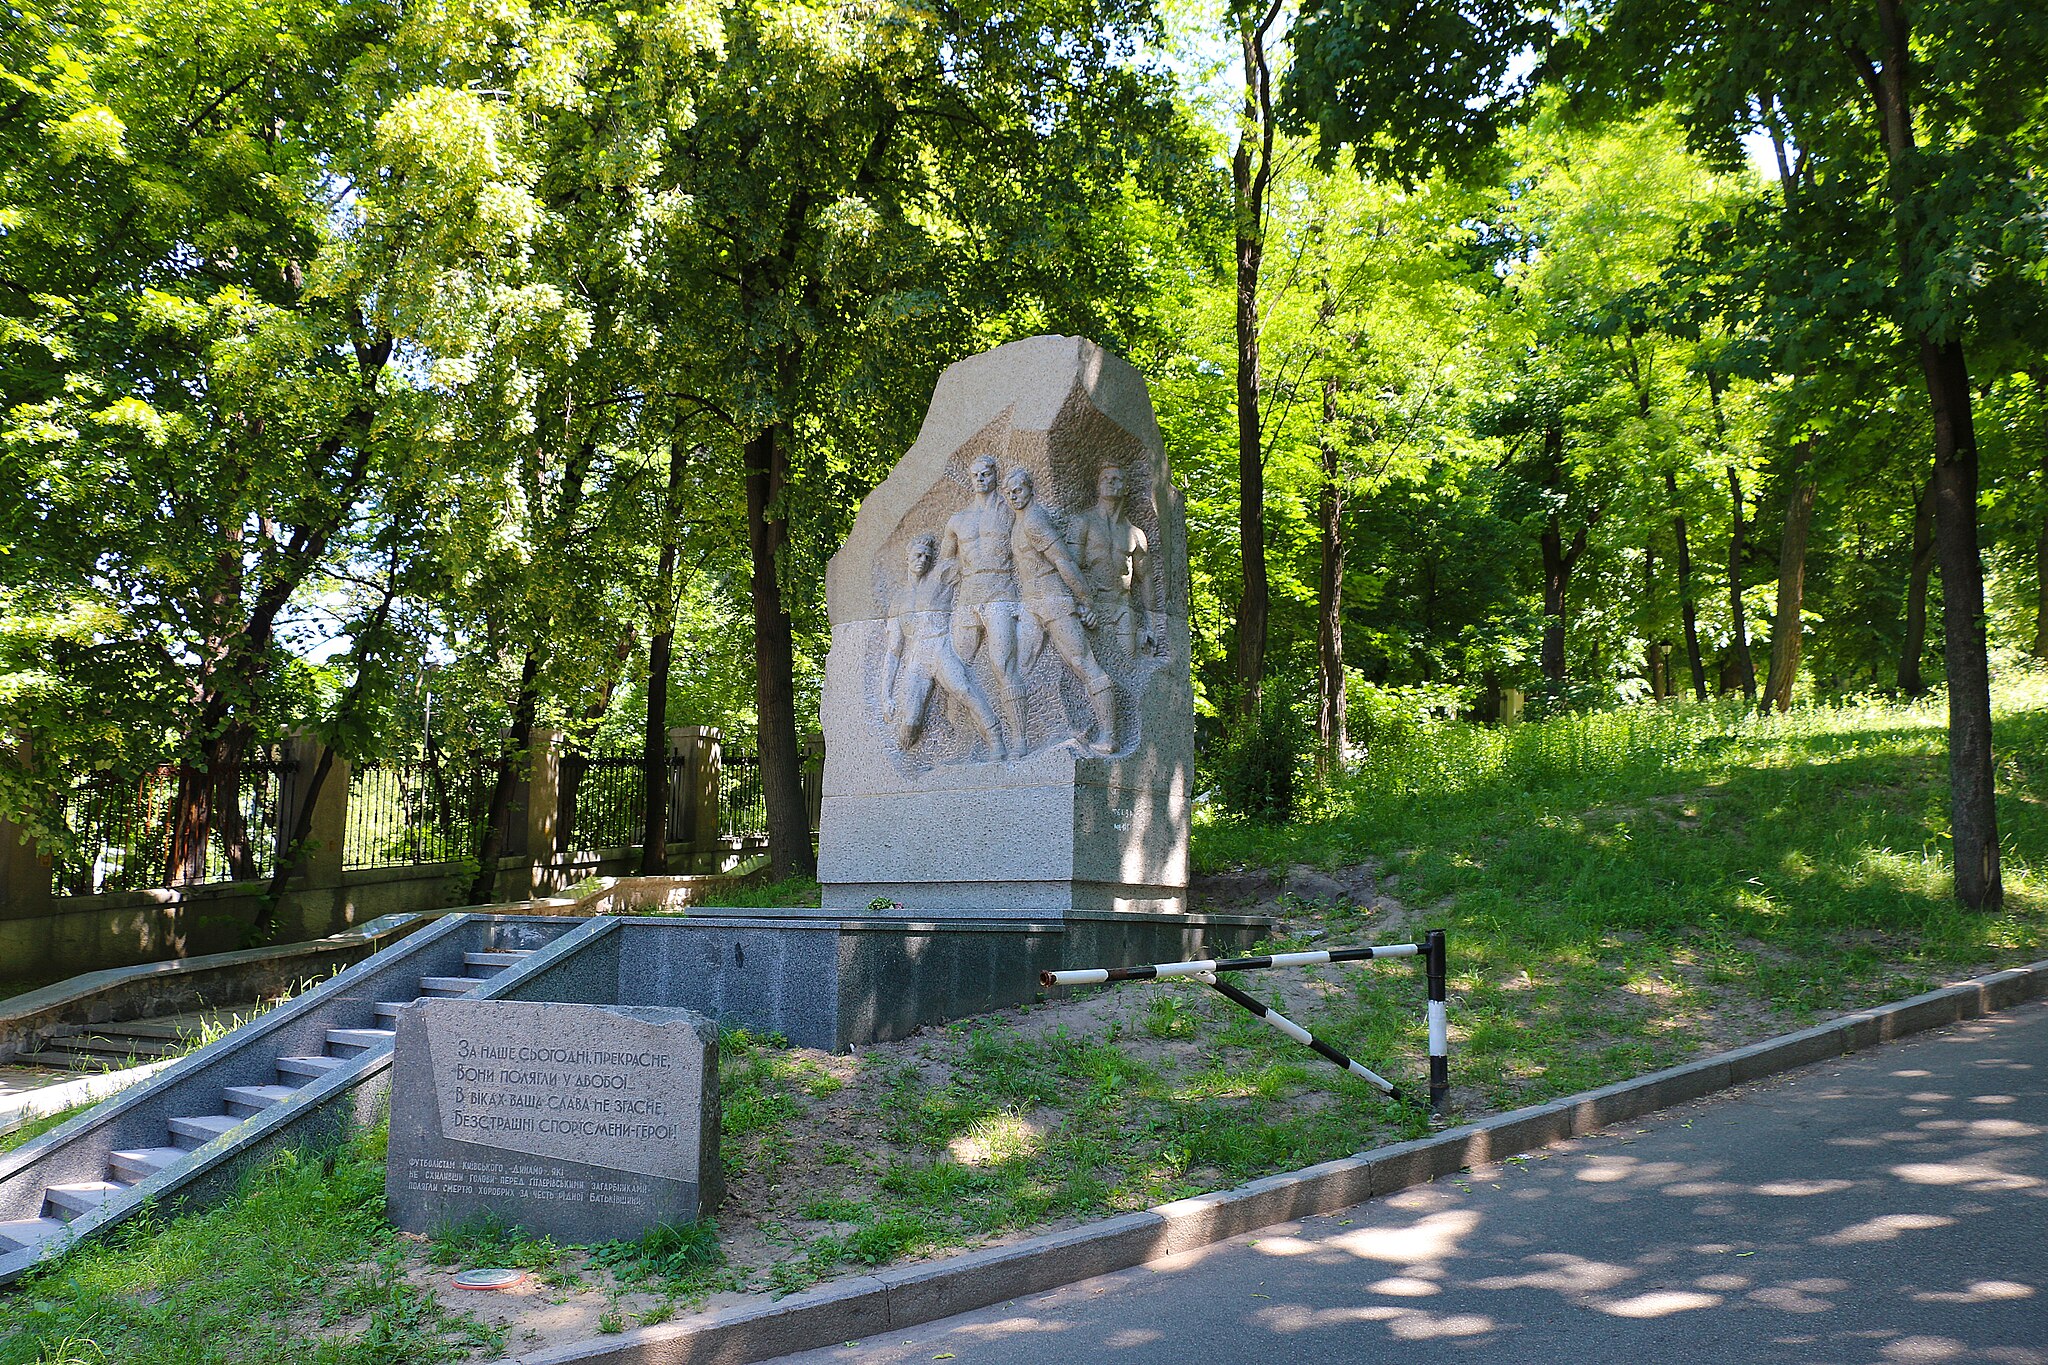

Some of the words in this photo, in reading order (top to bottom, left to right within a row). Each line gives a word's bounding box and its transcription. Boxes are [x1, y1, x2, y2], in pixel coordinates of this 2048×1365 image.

[458, 1040, 477, 1058] ЗА
[480, 1046, 516, 1060] НАШЕ
[594, 1051, 671, 1069] ПРЕКРАСНЕ,
[457, 1064, 494, 1083] ВОНИ
[501, 1070, 558, 1086] ПОЛЯГЛИ
[563, 1073, 572, 1087] У
[456, 1087, 465, 1103] В
[470, 1090, 504, 1106] ВІКАХ
[510, 1094, 543, 1109] ВАША
[548, 1096, 590, 1111] СЛАВА
[595, 1099, 610, 1112] НЕ
[455, 1110, 535, 1132] БЕЗСТРАШНІ
[408, 1158, 456, 1169] ФУТБОЛІСТАМ
[462, 1161, 504, 1173] КИЇВСЬКОГО
[425, 1171, 464, 1182] СХИЛИВШИ
[500, 1176, 525, 1186] ПЕРЕД
[408, 1182, 438, 1192] ПОЛЯГЛИ
[442, 1184, 473, 1194] СМЕРТЮ
[478, 1187, 515, 1197] ХОРОБРИХ
[519, 1189, 529, 1198] ЗА
